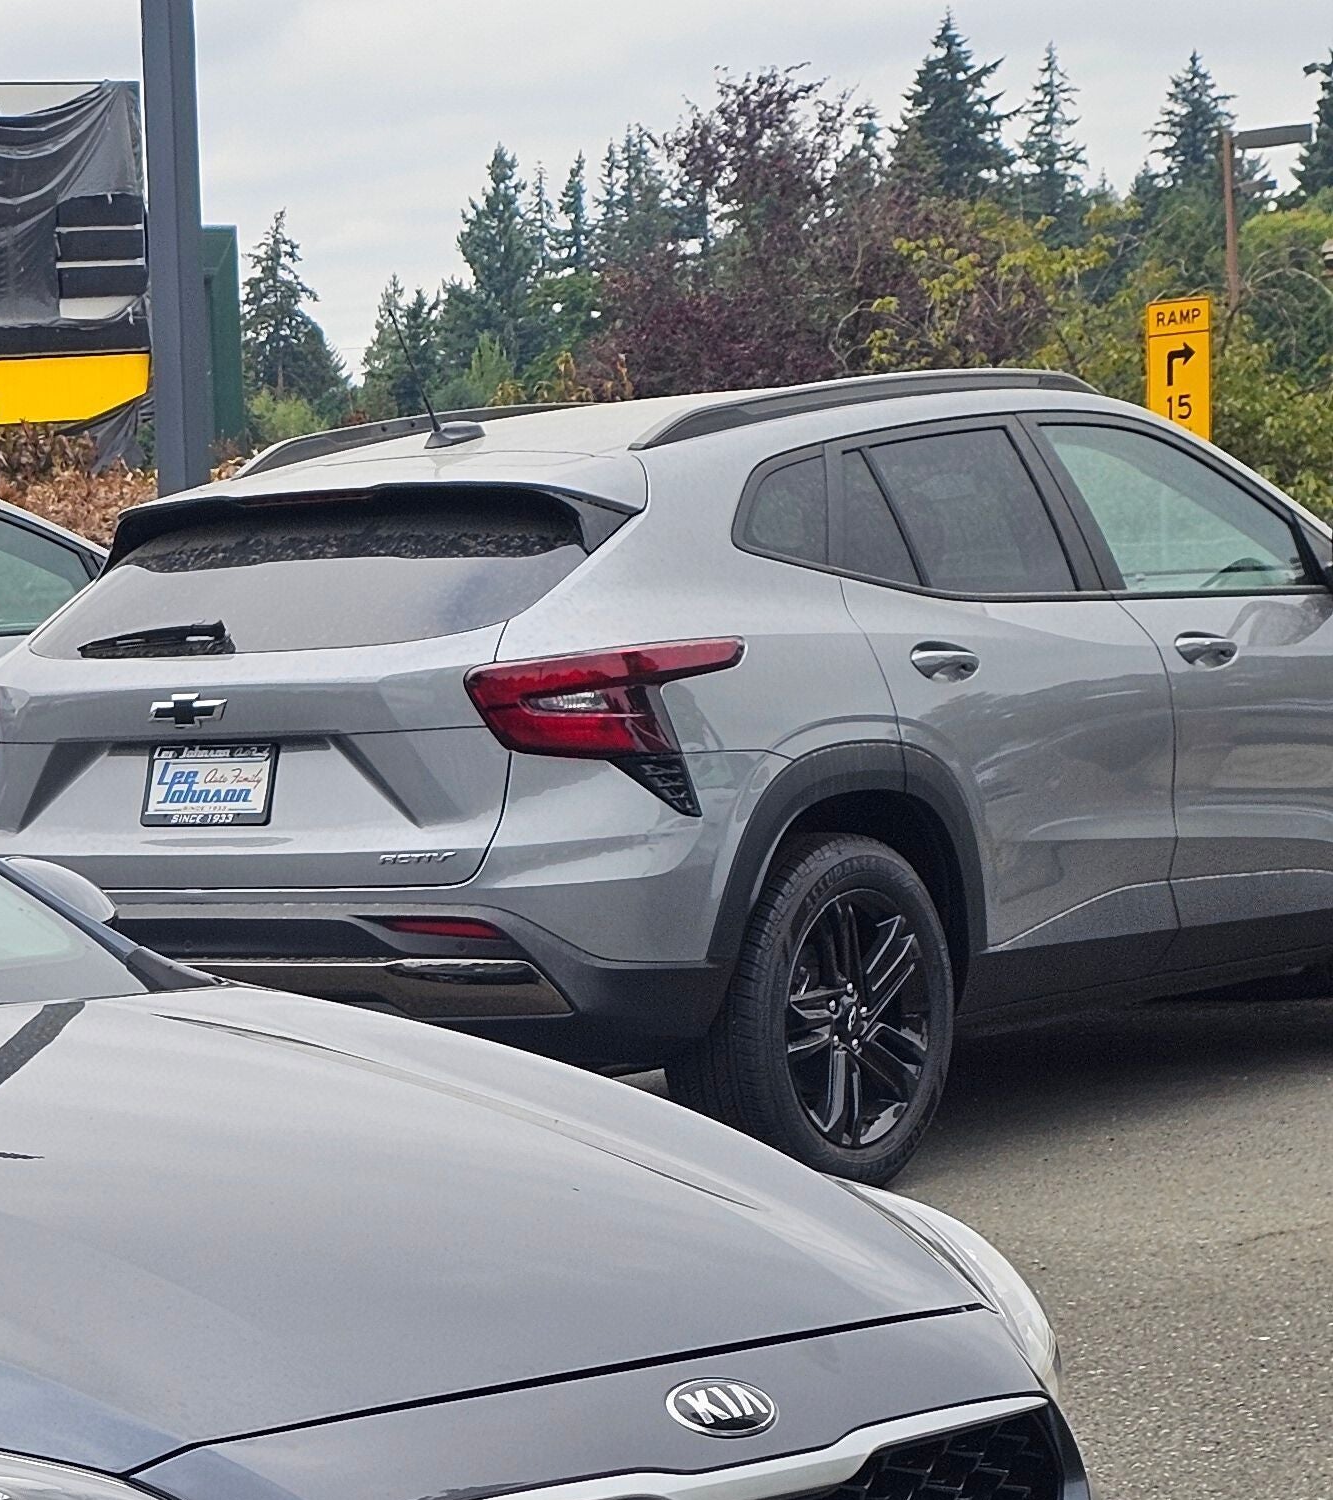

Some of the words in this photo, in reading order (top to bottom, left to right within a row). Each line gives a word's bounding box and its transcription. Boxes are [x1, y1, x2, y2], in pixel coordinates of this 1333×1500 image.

[1156, 308, 1201, 327] RAMP
[1166, 394, 1192, 420] 15
[157, 762, 200, 786] Lee
[204, 768, 227, 784] Auto
[229, 768, 263, 789] Family
[157, 782, 252, 804] Johnson
[171, 814, 203, 824] SINCE
[207, 813, 234, 823] 1933
[679, 1384, 769, 1425] KIA
